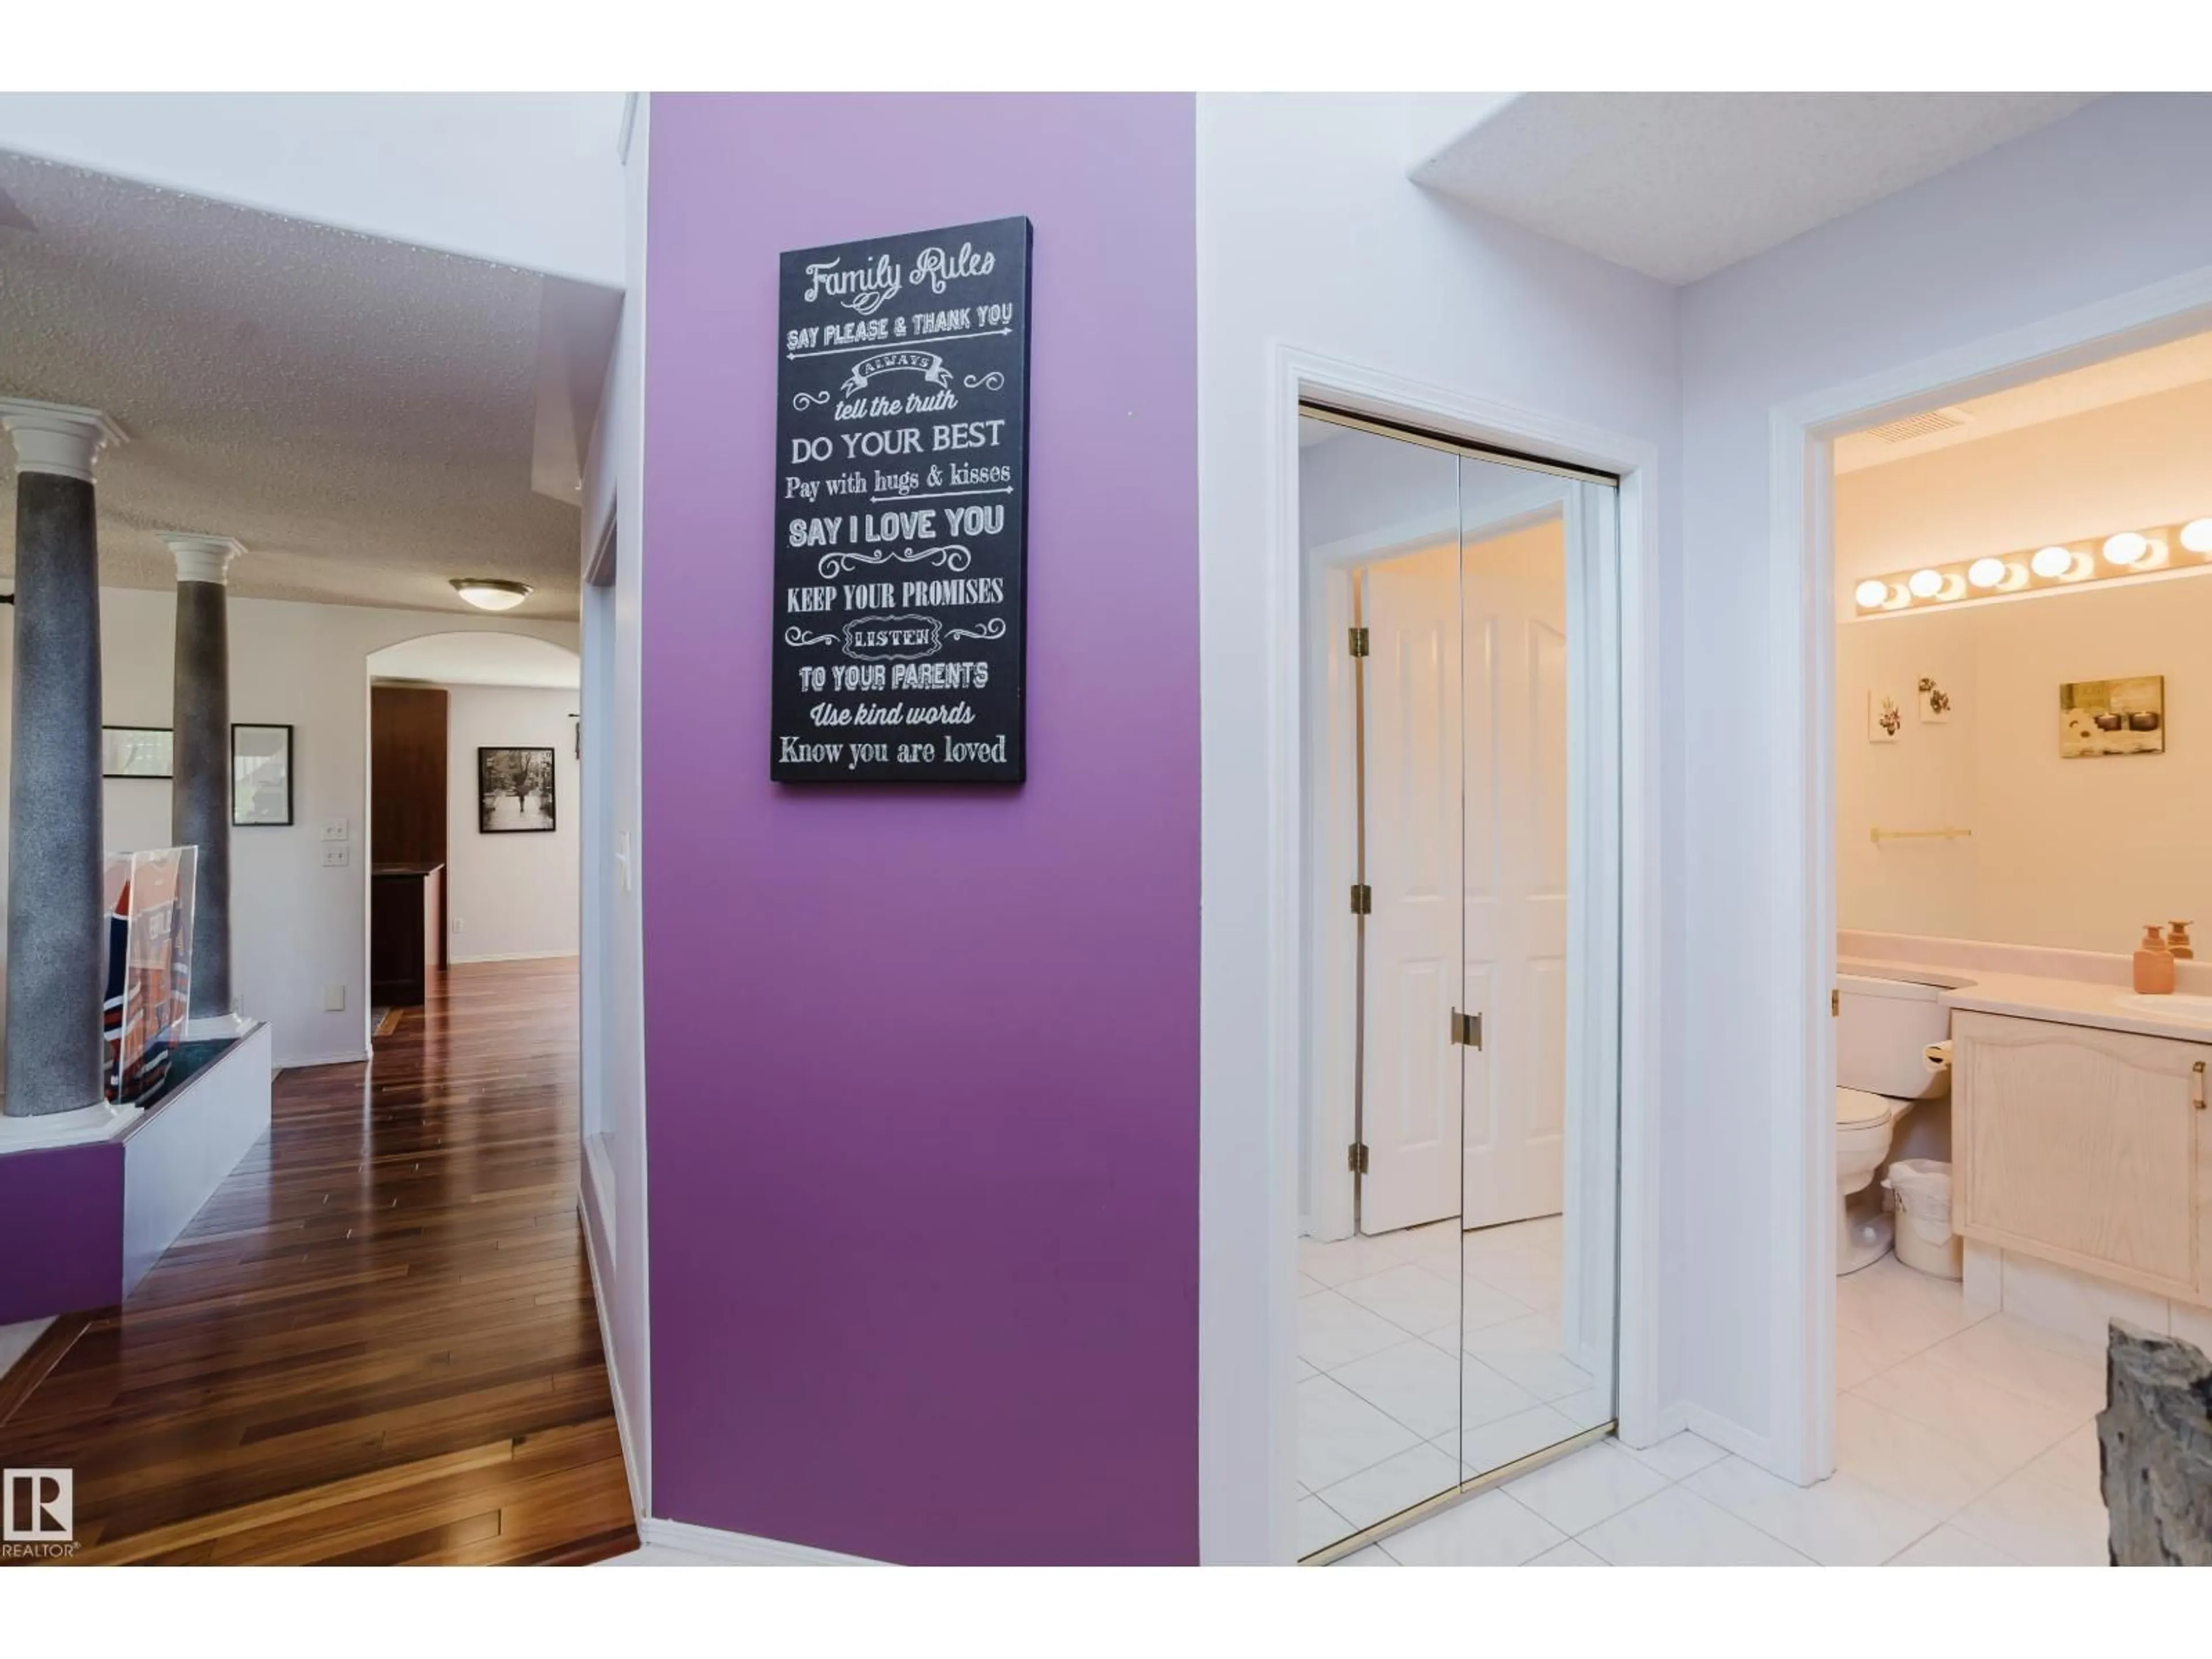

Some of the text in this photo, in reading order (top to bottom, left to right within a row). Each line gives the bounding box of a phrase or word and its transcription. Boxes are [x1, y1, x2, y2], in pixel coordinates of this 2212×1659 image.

[804, 242, 995, 315] Family Rules
[787, 302, 1012, 350] SAY PLEASE & THANK YOU
[865, 355, 929, 374] ALWAYS
[834, 389, 958, 421] tell the truth
[791, 420, 1005, 463] DO YOUR BEST
[785, 462, 1010, 502] Pay with hugs & kisses
[789, 505, 1004, 547] SAY I LOVE YOU
[787, 578, 1003, 613] KEEP YOUR PROMISES
[855, 629, 929, 646] LISTEN
[800, 661, 988, 692] TO YOUR PARENTS
[810, 701, 976, 726] Use kind words
[779, 735, 1007, 769] Know you are loved
